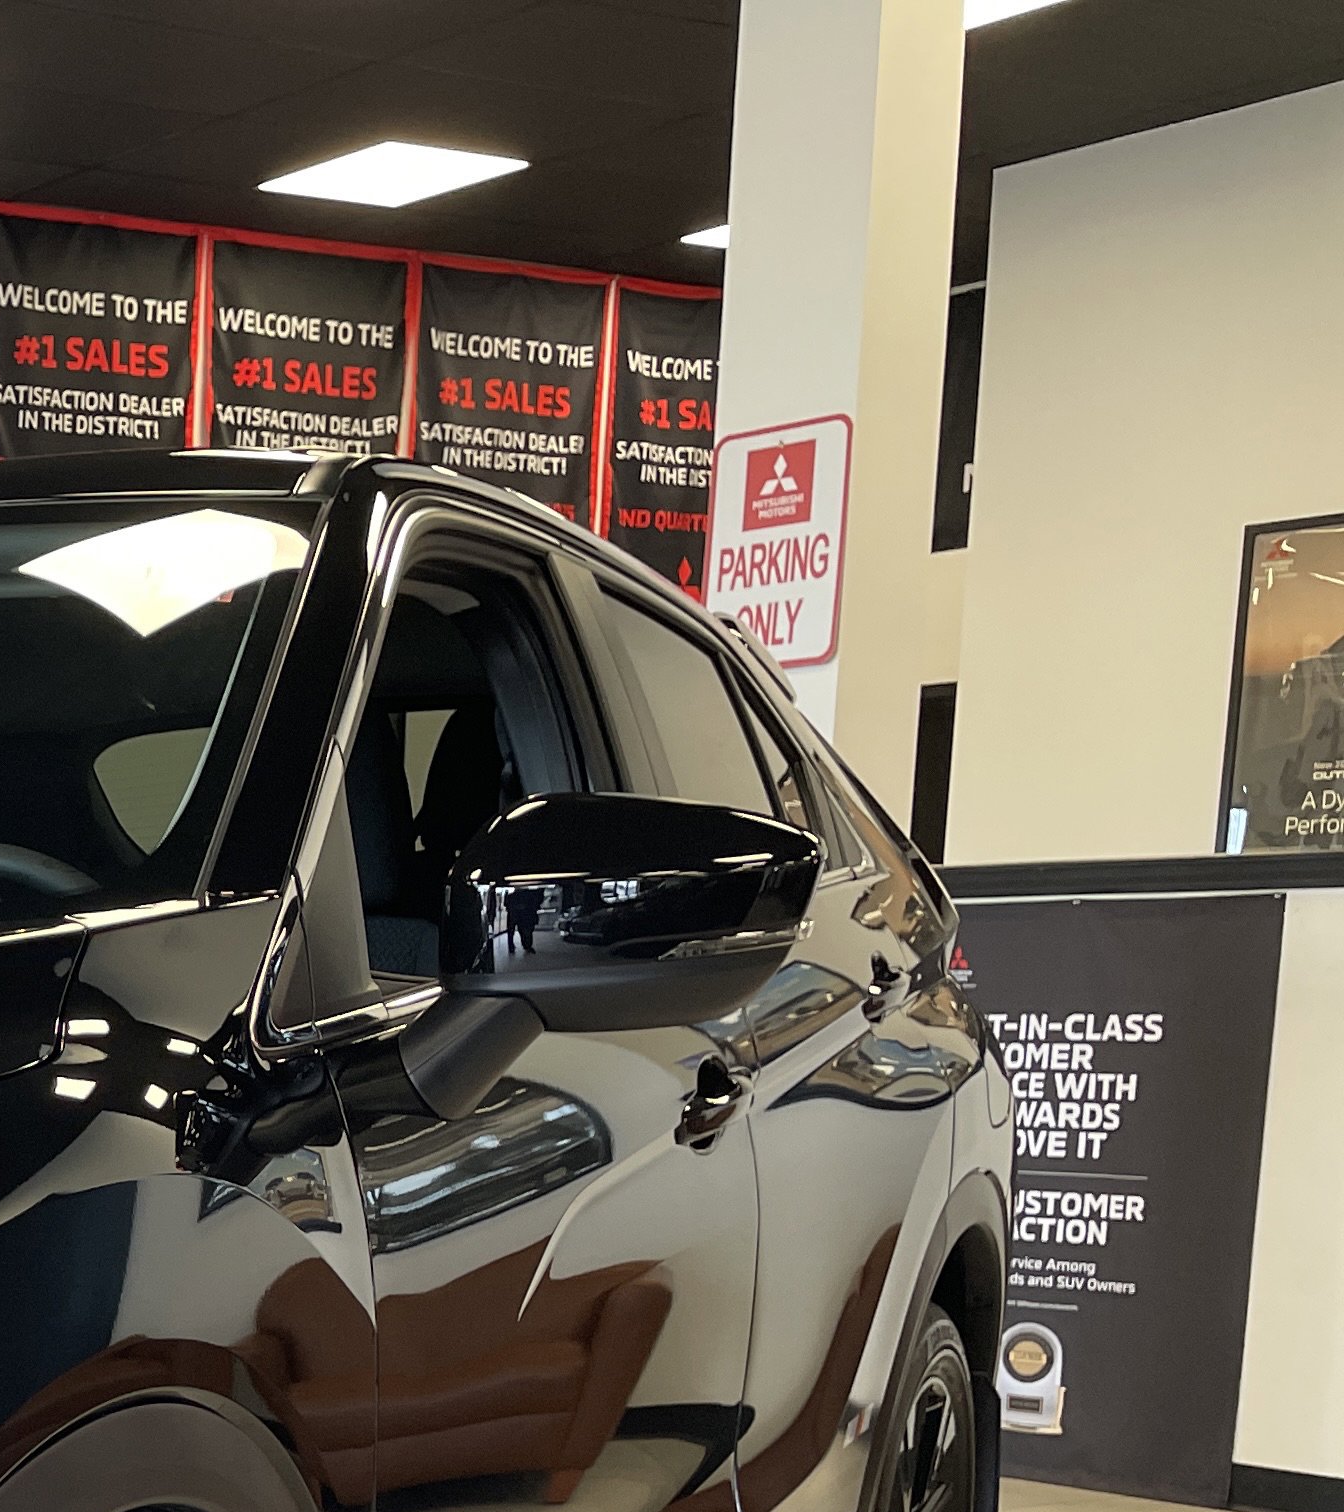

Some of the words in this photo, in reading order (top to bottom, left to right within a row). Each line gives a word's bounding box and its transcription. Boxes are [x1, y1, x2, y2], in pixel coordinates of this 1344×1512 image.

[111, 294, 139, 321] TO
[143, 299, 188, 324] THE
[219, 307, 321, 342] WELCOME
[325, 319, 353, 345] TO
[357, 322, 394, 349] THE
[14, 335, 57, 369] #1
[65, 336, 169, 378] SALES
[430, 327, 522, 361] WELCOME
[526, 340, 552, 364] TO
[556, 343, 594, 368] THE
[233, 357, 276, 390] #1
[283, 359, 377, 400] SALES
[627, 350, 713, 381] WELCOME
[118, 392, 184, 417] DEALER
[439, 377, 476, 409] #1
[484, 378, 571, 419] SALES
[18, 409, 38, 429] IN
[41, 411, 73, 433] THE
[75, 414, 159, 440] DISTRICT!
[329, 415, 398, 437] DEALER
[639, 398, 670, 430] #1
[236, 429, 256, 447] IN
[261, 431, 291, 449] THE
[420, 421, 526, 450] SATISFACTION
[442, 446, 461, 466] IN
[465, 448, 492, 469] THE
[494, 451, 567, 476] DISTRICT!
[640, 464, 656, 483] IN
[659, 467, 687, 486] THE
[752, 493, 804, 511] MITSUBISHI
[759, 506, 796, 519] MOTORS
[717, 533, 830, 592] PARKING
[1301, 791, 1316, 810] A
[987, 1013, 1164, 1042] T-IN-CLASS
[1055, 1073, 1138, 1102] WITH
[1077, 1131, 1108, 1160] IT
[1014, 1190, 1145, 1222] USTOMER
[1046, 1258, 1096, 1276] Among
[1027, 1275, 1053, 1288] and
[1057, 1276, 1085, 1290] SUV
[1087, 1278, 1136, 1295] Owners
